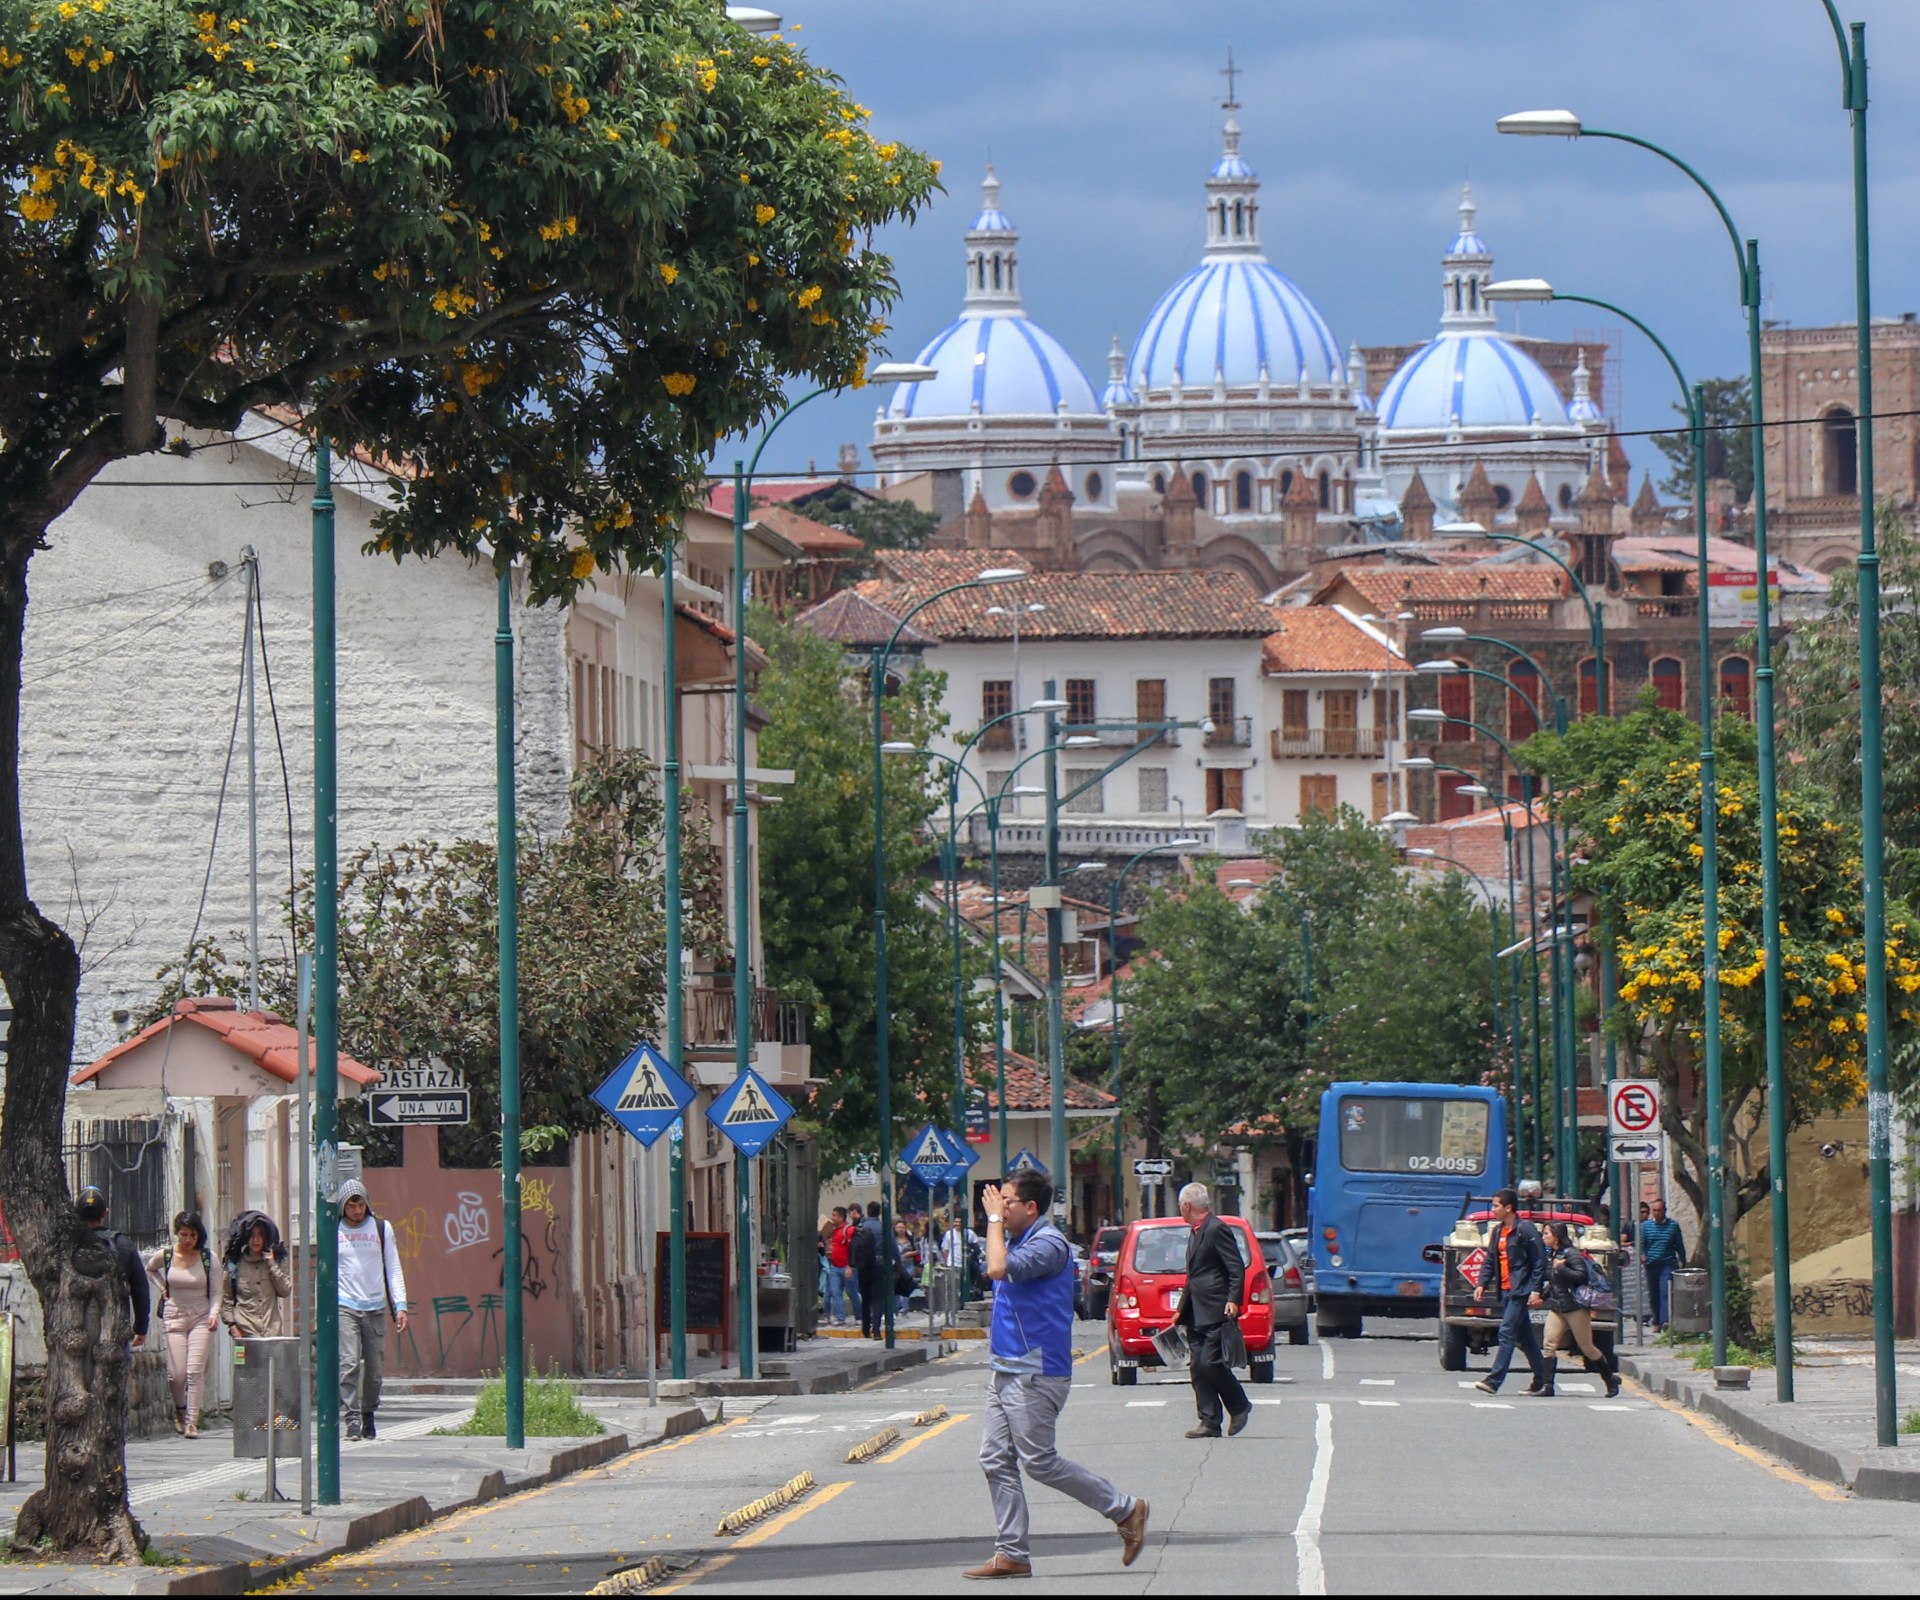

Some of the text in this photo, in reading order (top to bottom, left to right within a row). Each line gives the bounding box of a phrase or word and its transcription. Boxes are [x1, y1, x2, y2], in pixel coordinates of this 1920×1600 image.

[378, 1071, 461, 1089] PASTAZA
[399, 1101, 457, 1114] UNA VIA
[1408, 1156, 1477, 1172] 02-0095
